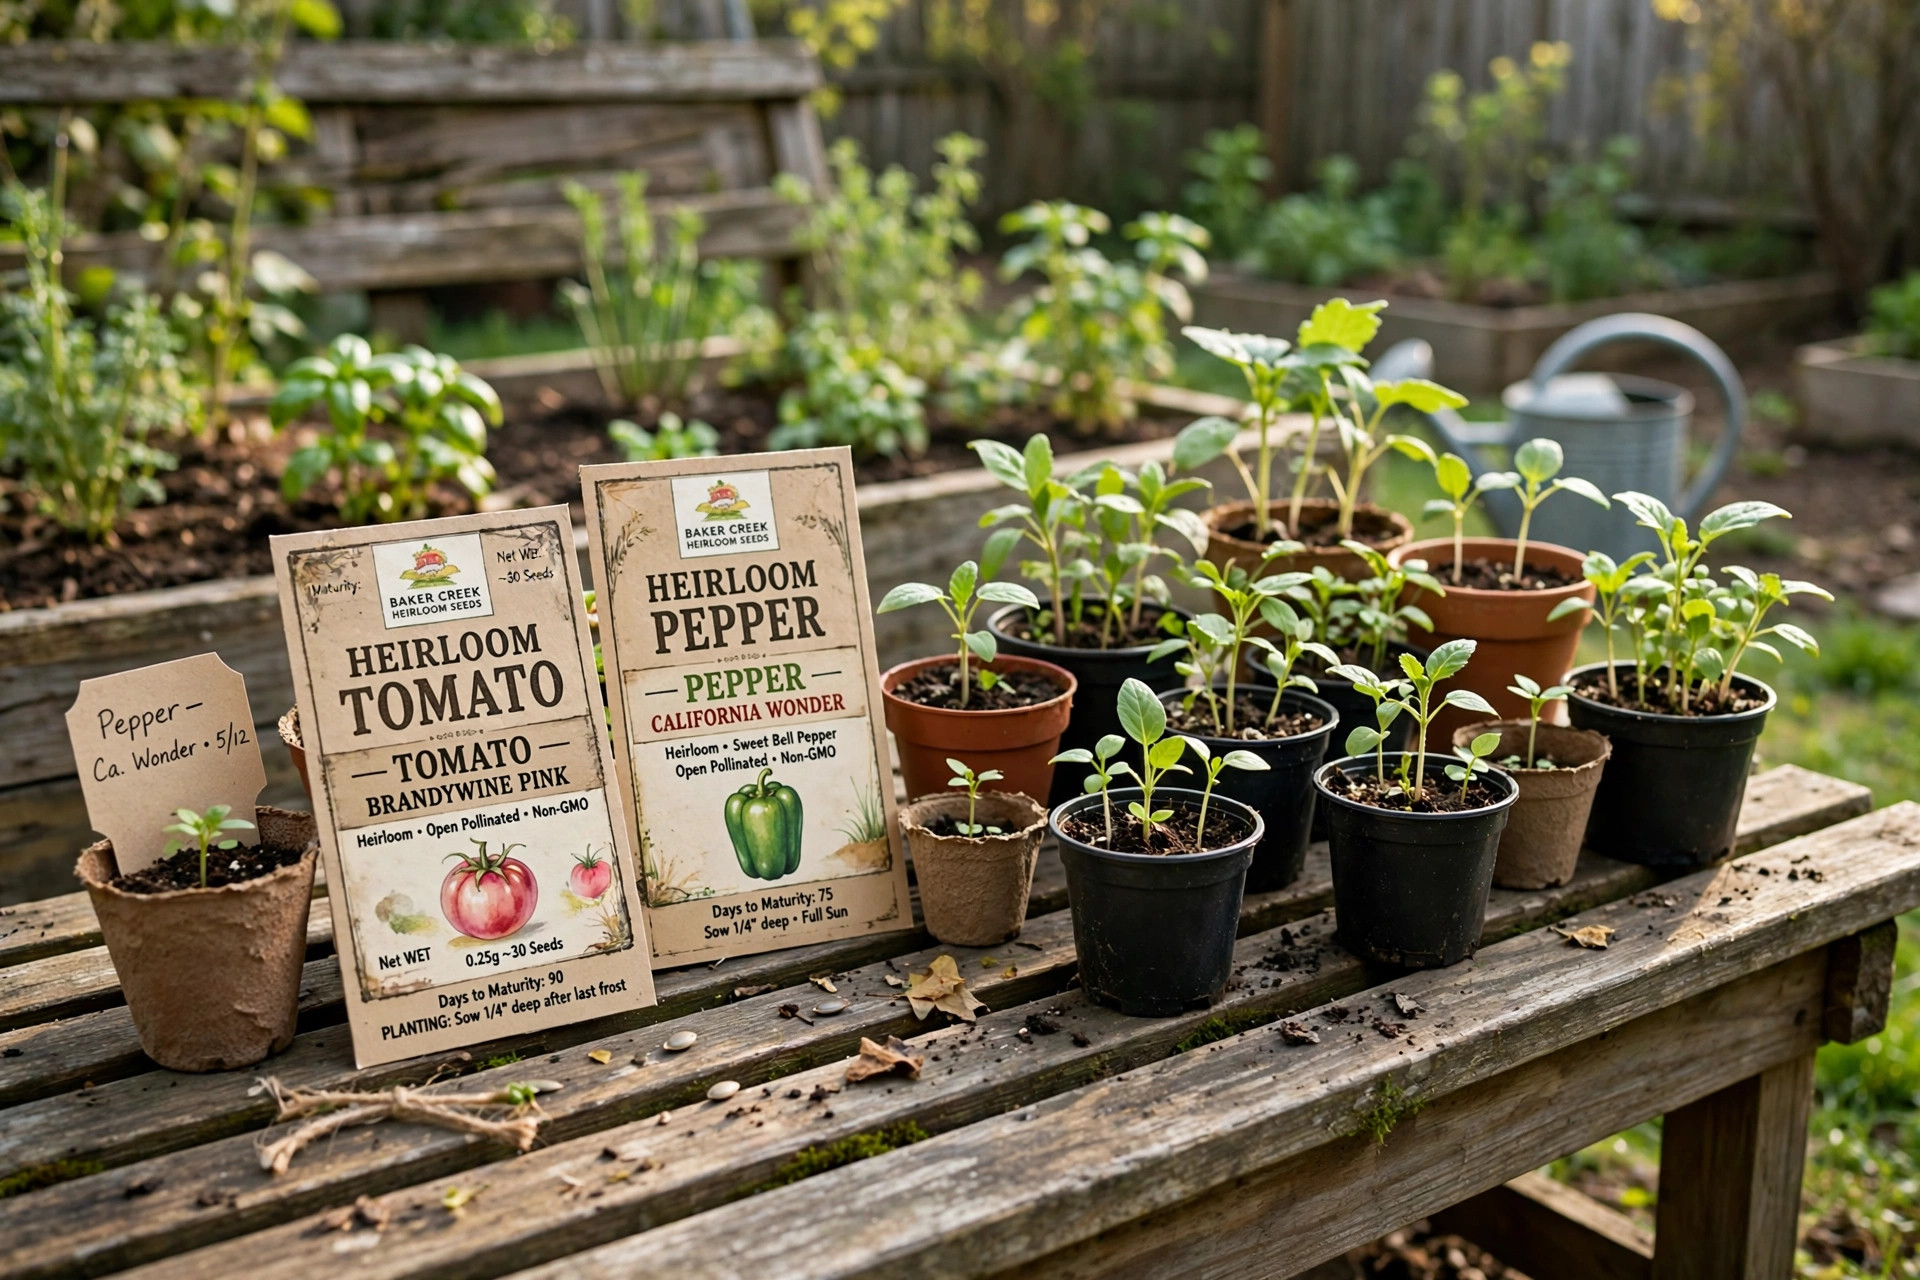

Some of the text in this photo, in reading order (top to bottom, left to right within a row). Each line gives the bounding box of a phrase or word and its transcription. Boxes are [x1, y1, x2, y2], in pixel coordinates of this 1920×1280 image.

[685, 522, 768, 538] BAKER CREEK
[687, 534, 769, 550] HEIRLOOM SEEDS
[390, 586, 480, 608] BAKER CREEK
[646, 560, 818, 602] HEIRLOOM
[392, 600, 482, 619] HEIRLOOM SEEDS
[651, 596, 826, 654] PEPPER
[346, 623, 542, 678] HEIRLOOM
[339, 660, 564, 736] TOMATO
[684, 663, 806, 703] PEPPER
[98, 704, 179, 741] Pepper
[652, 693, 845, 733] CALIFORNIA WONDER
[93, 757, 125, 782] Ca.
[132, 739, 196, 770] Wonder
[216, 722, 250, 755] 5/12
[392, 736, 531, 782] TOMATO
[665, 743, 719, 760] Heirloom
[733, 736, 769, 752] Sweet
[772, 732, 794, 746] Bell
[797, 729, 837, 745] Pepper
[676, 764, 707, 780] Open
[710, 750, 768, 773] Pollinated
[781, 745, 836, 764] Non-GMO
[366, 766, 570, 817] BRANDYWINE PINK
[356, 828, 413, 848] Heirloom
[426, 820, 458, 839] Open
[461, 810, 520, 830] Pollinated
[532, 797, 589, 819] Non-GMO
[704, 926, 729, 939] Sow
[734, 918, 757, 934] 1/4"
[761, 915, 790, 932] deep
[802, 908, 822, 924] Full
[826, 906, 848, 919] Sun
[712, 887, 834, 920] Days to Maturity: 75
[379, 947, 431, 970] Net WET
[466, 937, 564, 968] 0.25g ~30 Seeds
[382, 979, 628, 1041] PLANTING: Sow 1/4" deep after last frost
[439, 970, 564, 1010] Days to Maturity: 90
